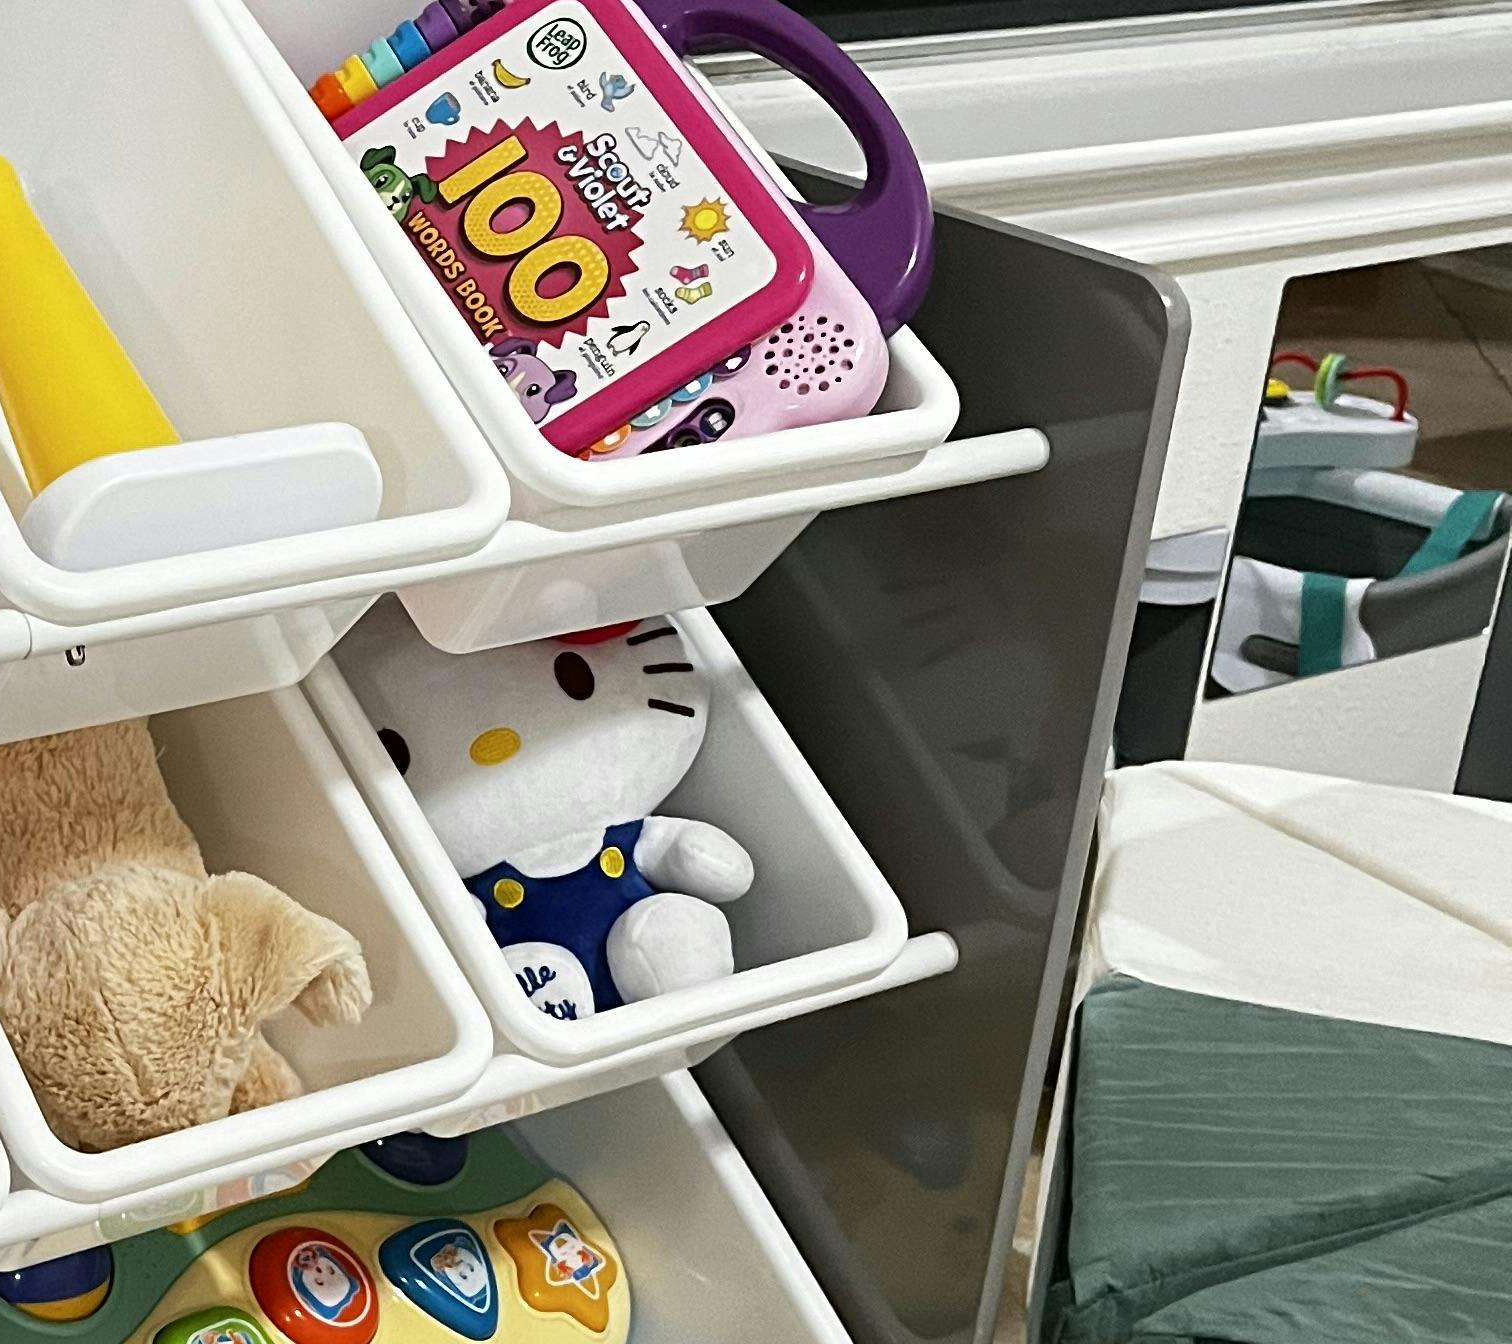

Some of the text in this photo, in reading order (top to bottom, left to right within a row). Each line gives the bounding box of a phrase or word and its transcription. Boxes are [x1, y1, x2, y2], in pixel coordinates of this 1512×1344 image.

[536, 36, 570, 66] Frog
[547, 23, 581, 51] Leap
[576, 79, 598, 100] bird
[586, 133, 651, 207] Scout
[656, 163, 681, 189] cloud
[438, 134, 610, 323] 100
[407, 210, 504, 338] WORDS BOOK
[654, 287, 678, 315] socks
[583, 337, 616, 378] penguin
